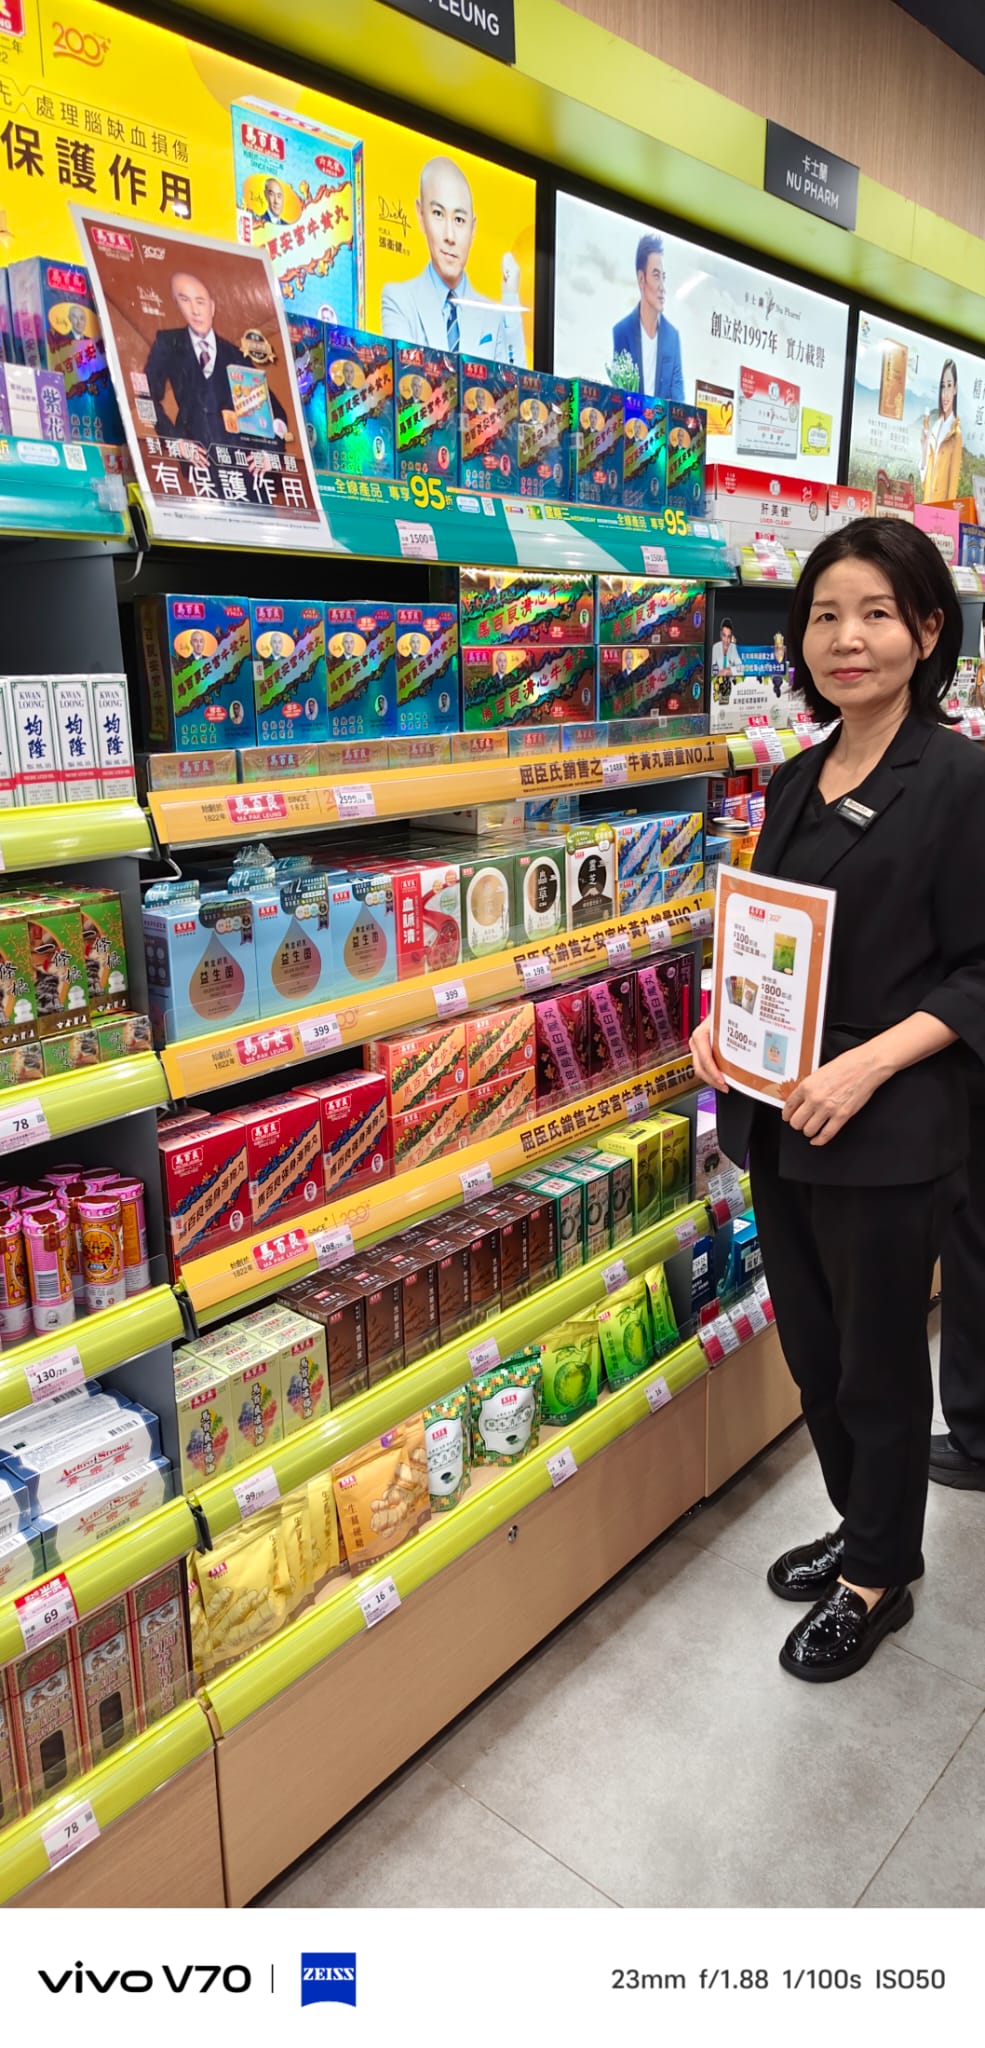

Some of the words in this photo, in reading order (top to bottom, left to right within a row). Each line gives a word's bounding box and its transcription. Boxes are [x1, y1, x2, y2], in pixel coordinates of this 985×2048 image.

[36, 95, 189, 164] 處理腦缺血損傷
[0, 119, 192, 221] 保護作用
[801, 154, 828, 184] 卡士蘭
[786, 169, 802, 191] NU
[803, 178, 840, 210] PHARM
[711, 311, 778, 355] 創立於1997年
[215, 445, 299, 473] 腦血管問題
[151, 461, 308, 509] 有保護作用
[410, 475, 446, 510] 95
[663, 509, 688, 537] 95
[409, 533, 429, 544] 1500
[177, 635, 249, 698] 馬百良安宮牛黃丸
[259, 635, 323, 696] 馬百良安宮牛黃丸
[19, 691, 41, 700] KWAN
[60, 690, 82, 699] KWAN
[99, 690, 120, 699] KWAN
[18, 700, 45, 709] LOONG
[59, 699, 85, 709] LOONG
[98, 699, 123, 708] LOONG
[24, 714, 47, 759] 均隆
[65, 713, 87, 757] 均隆
[103, 713, 124, 756] 均隆
[519, 741, 714, 787] 屈臣氏銷售之牛黃丸銷量NO.1
[235, 793, 281, 815] 馬百良
[289, 802, 311, 811] 1822
[236, 814, 249, 822] MA
[249, 812, 261, 821] PAK
[262, 810, 283, 820] LEUNG
[352, 931, 379, 949] 益生菌
[615, 940, 627, 953] 198
[280, 947, 313, 966] 益生菌
[199, 965, 235, 984] 益生菌
[533, 966, 546, 977] 198
[445, 990, 459, 1001] 399
[761, 983, 782, 997] $800
[313, 1024, 331, 1038] 399
[241, 1029, 294, 1057] 馬百良
[245, 1055, 258, 1063] MA
[258, 1052, 270, 1060] PAK
[270, 1045, 290, 1056] LEUNG
[327, 1097, 348, 1111] 馬百良
[13, 1118, 30, 1132] 78
[253, 1123, 276, 1138] 馬百良
[175, 1150, 198, 1165] 馬百良
[259, 1231, 302, 1261] 馬百良
[274, 1257, 286, 1265] PAK
[655, 1388, 663, 1396] 16
[558, 1457, 566, 1466] 16
[375, 1592, 386, 1604] 16
[43, 1608, 59, 1624] 69
[64, 1822, 79, 1839] 78
